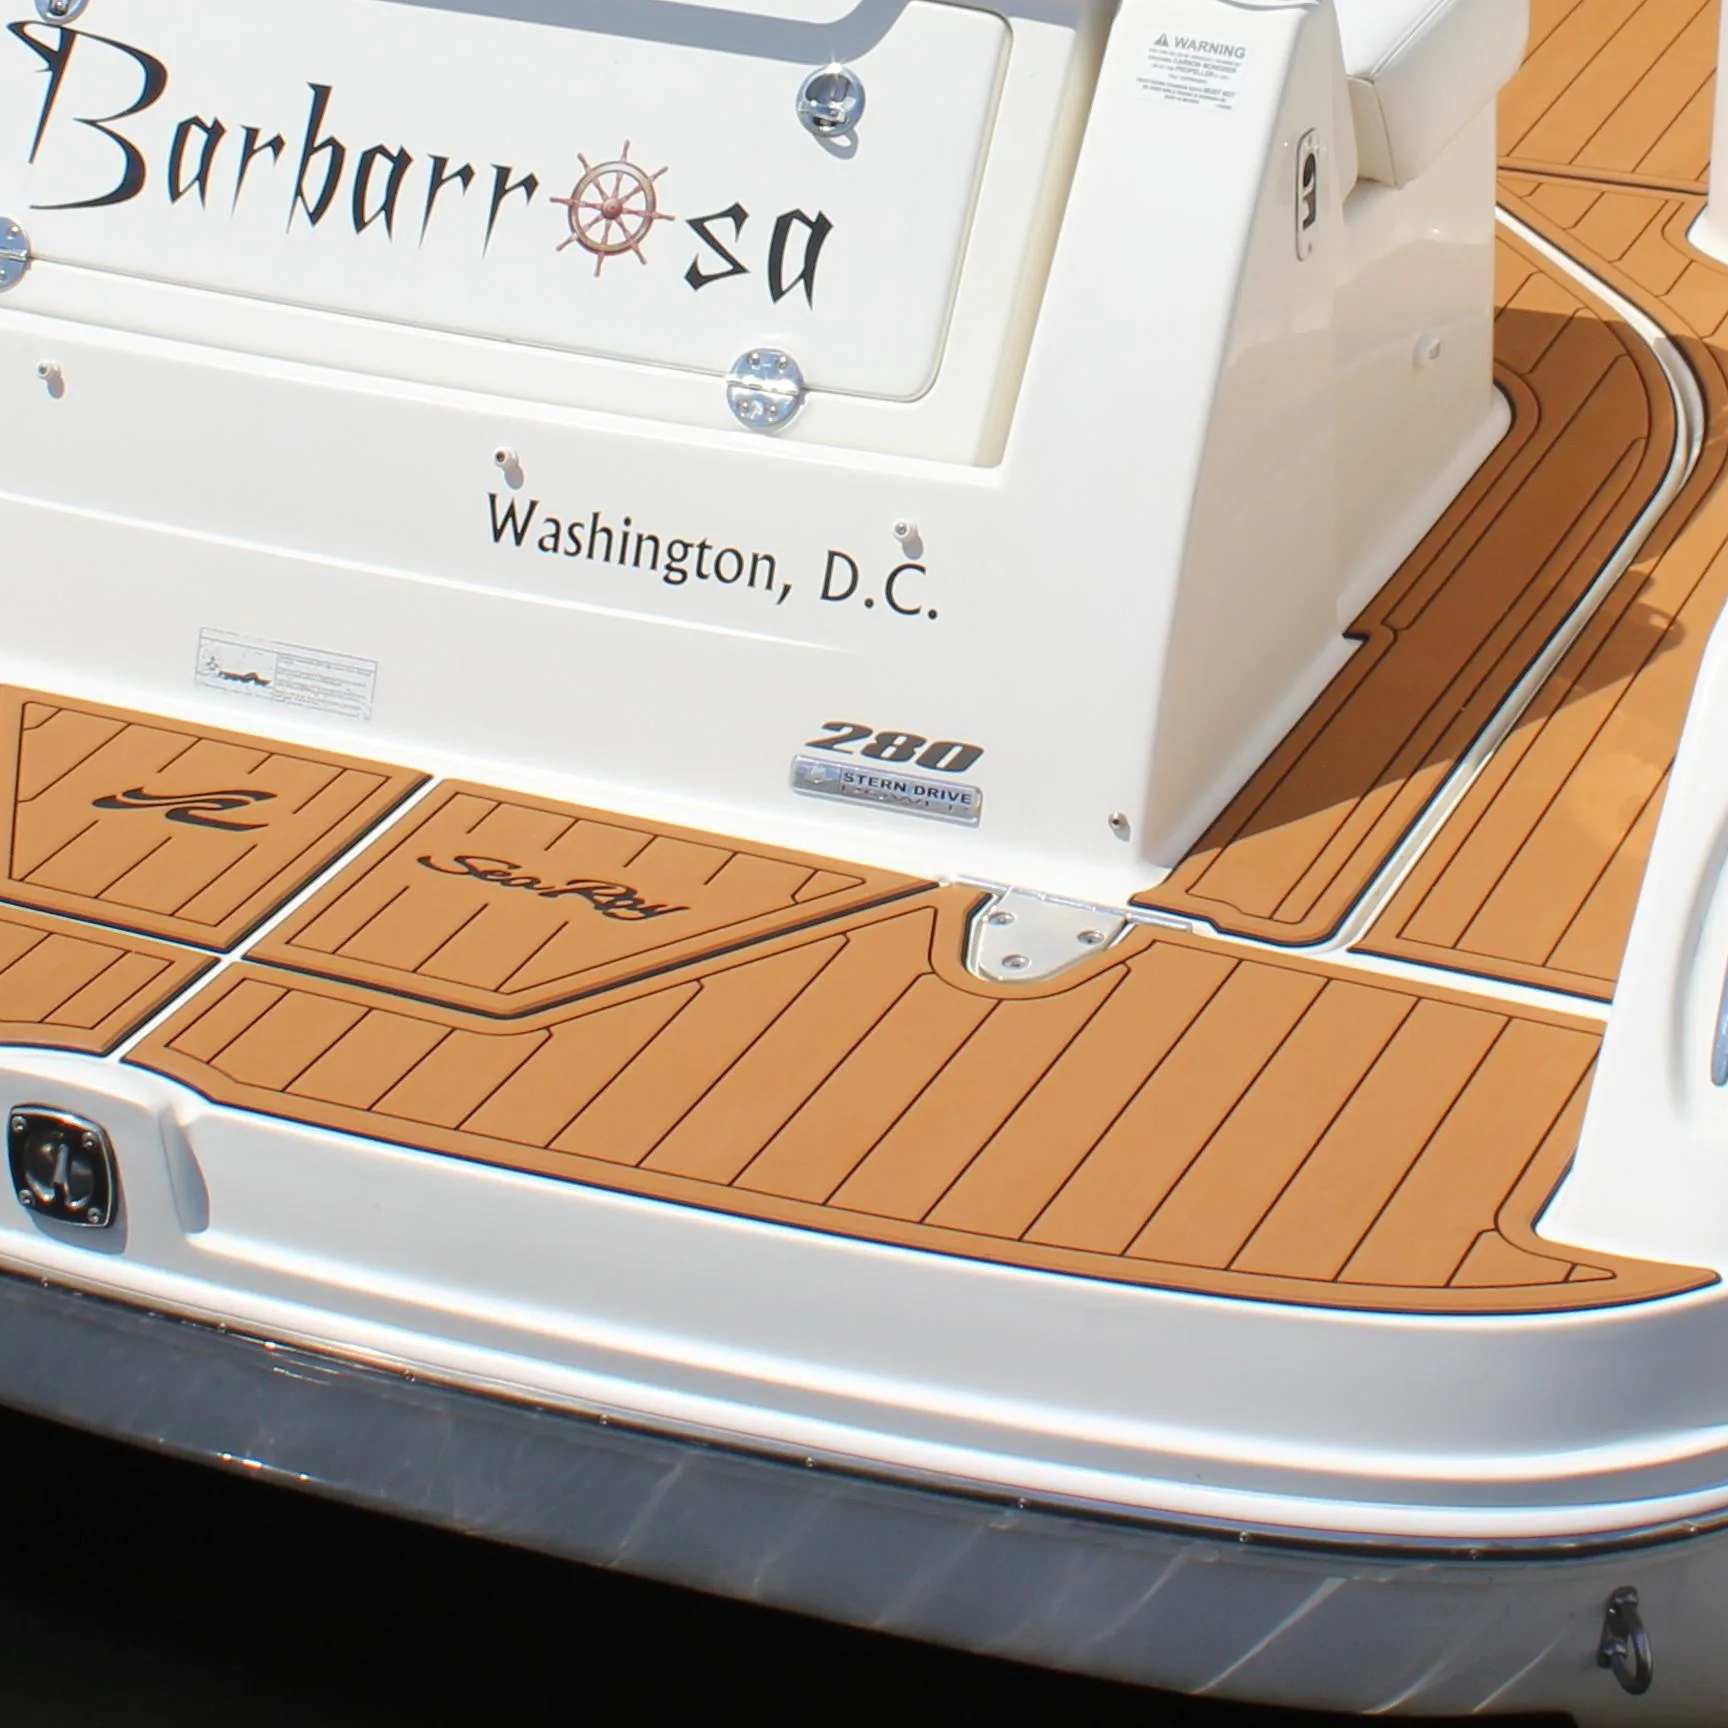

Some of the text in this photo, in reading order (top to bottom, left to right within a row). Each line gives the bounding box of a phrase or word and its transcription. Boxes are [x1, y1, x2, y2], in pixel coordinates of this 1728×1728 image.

[1174, 36, 1246, 59] WARNING
[486, 492, 940, 621] Washington, D.C.
[805, 720, 985, 773] 280
[843, 772, 973, 806] STERN DRIVE
[417, 854, 692, 922] Sea Ray
